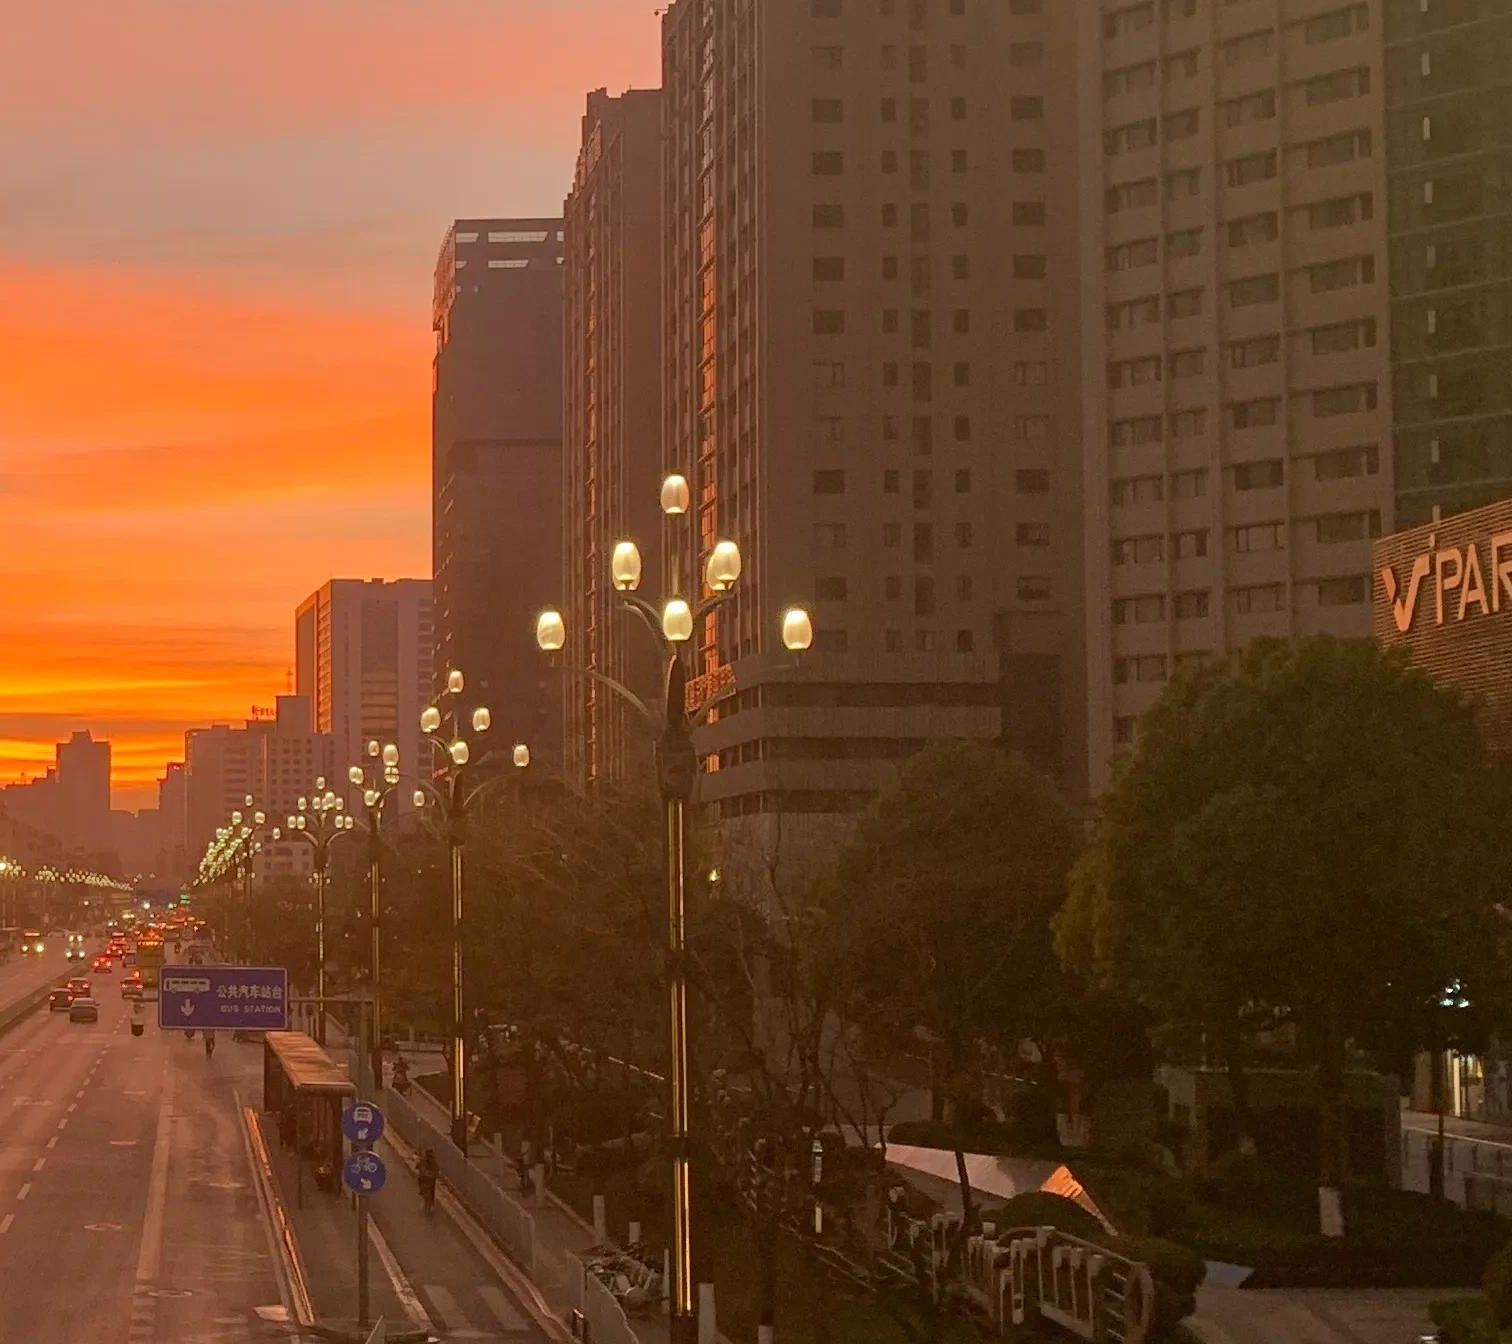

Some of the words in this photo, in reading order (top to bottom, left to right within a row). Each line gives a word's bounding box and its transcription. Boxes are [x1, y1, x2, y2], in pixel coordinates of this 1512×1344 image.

[216, 984, 282, 999] 公共汽车站台
[220, 1004, 238, 1013] BUS
[244, 1004, 281, 1014] STATION
